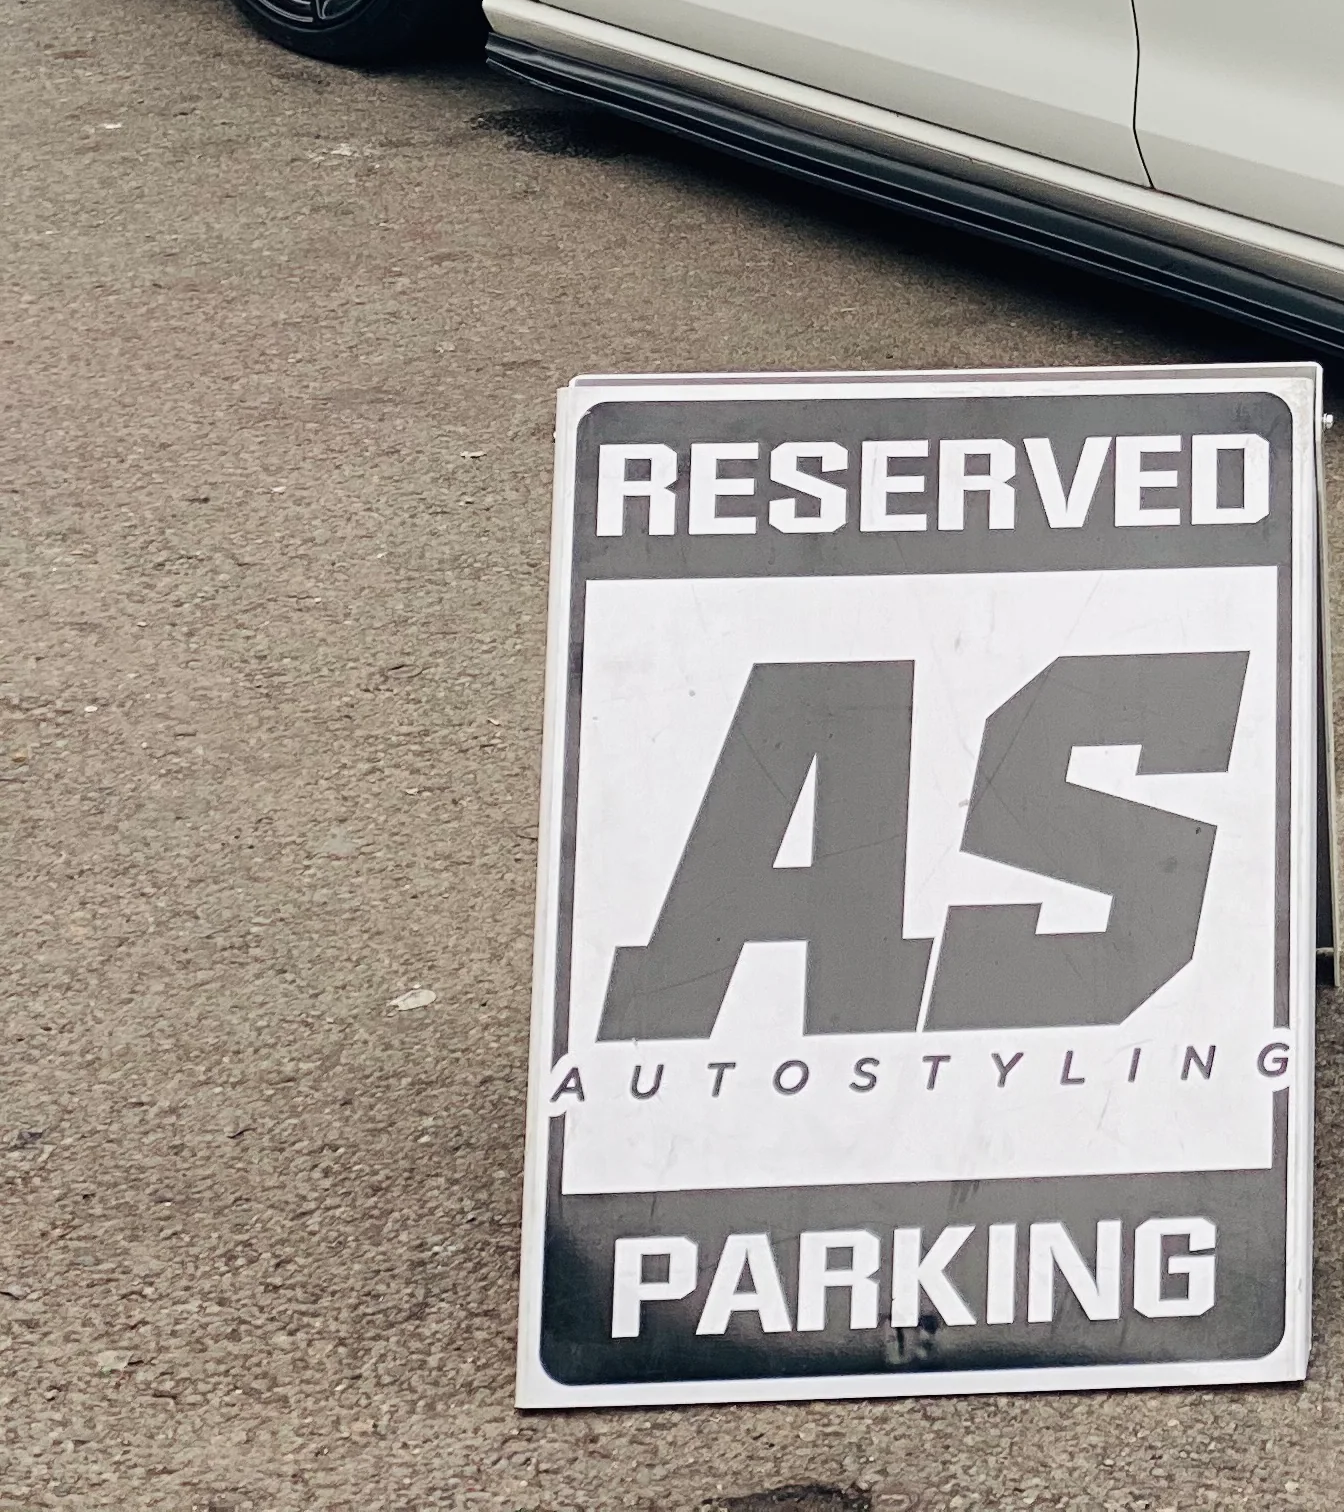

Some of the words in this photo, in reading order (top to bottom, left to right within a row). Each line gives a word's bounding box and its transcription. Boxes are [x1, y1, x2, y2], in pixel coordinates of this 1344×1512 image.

[595, 432, 1269, 537] RESERVED
[596, 650, 1250, 1042] AS
[549, 1040, 1292, 1103] AUTOSTYLING
[610, 1216, 1217, 1339] PARKING
